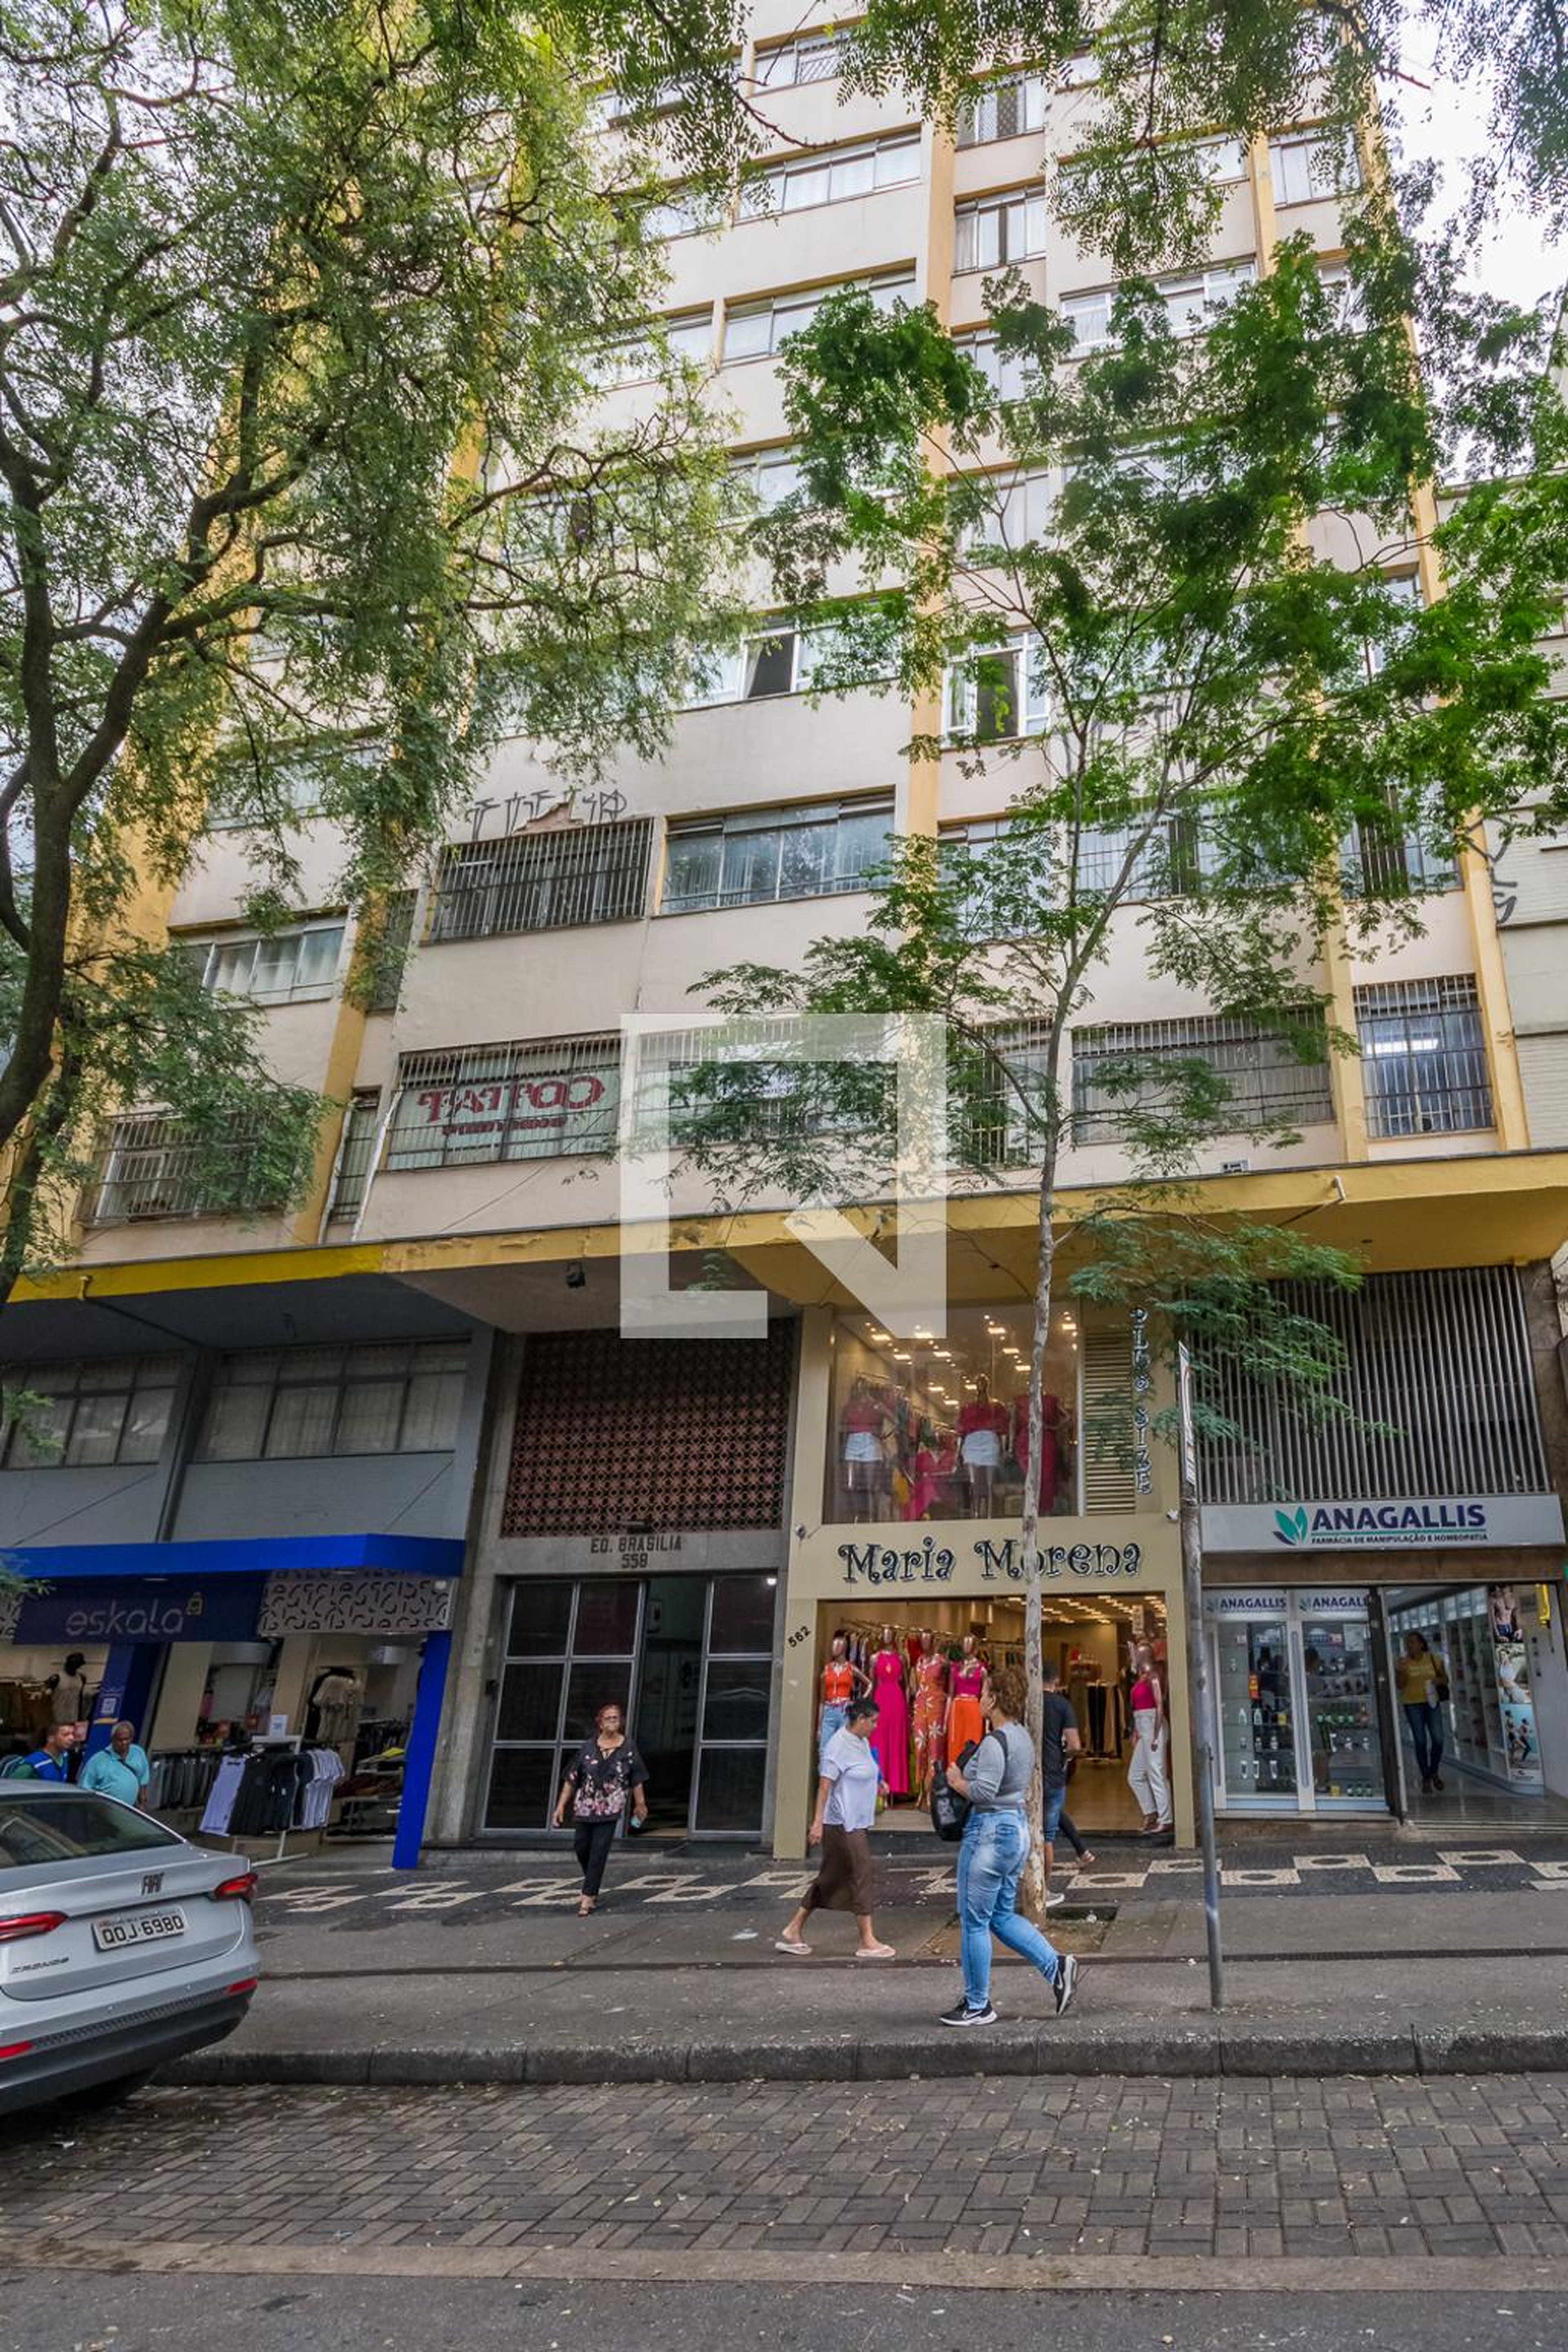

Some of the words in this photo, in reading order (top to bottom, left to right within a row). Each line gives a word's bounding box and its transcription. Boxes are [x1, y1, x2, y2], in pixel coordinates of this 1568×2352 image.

[1312, 1504, 1486, 1530] ANAGALLIS
[590, 1538, 612, 1553] ED.
[1366, 1533, 1425, 1543] MANIPULAÇÃO
[1434, 1533, 1488, 1542] HOMEOPATIA
[621, 1553, 648, 1568] 558
[838, 1536, 956, 1583] Maria
[1220, 1597, 1287, 1608] ANAGALLIS
[1312, 1597, 1370, 1607] ANAGALL
[65, 1599, 185, 1636] eskala
[788, 1626, 811, 1648] 562
